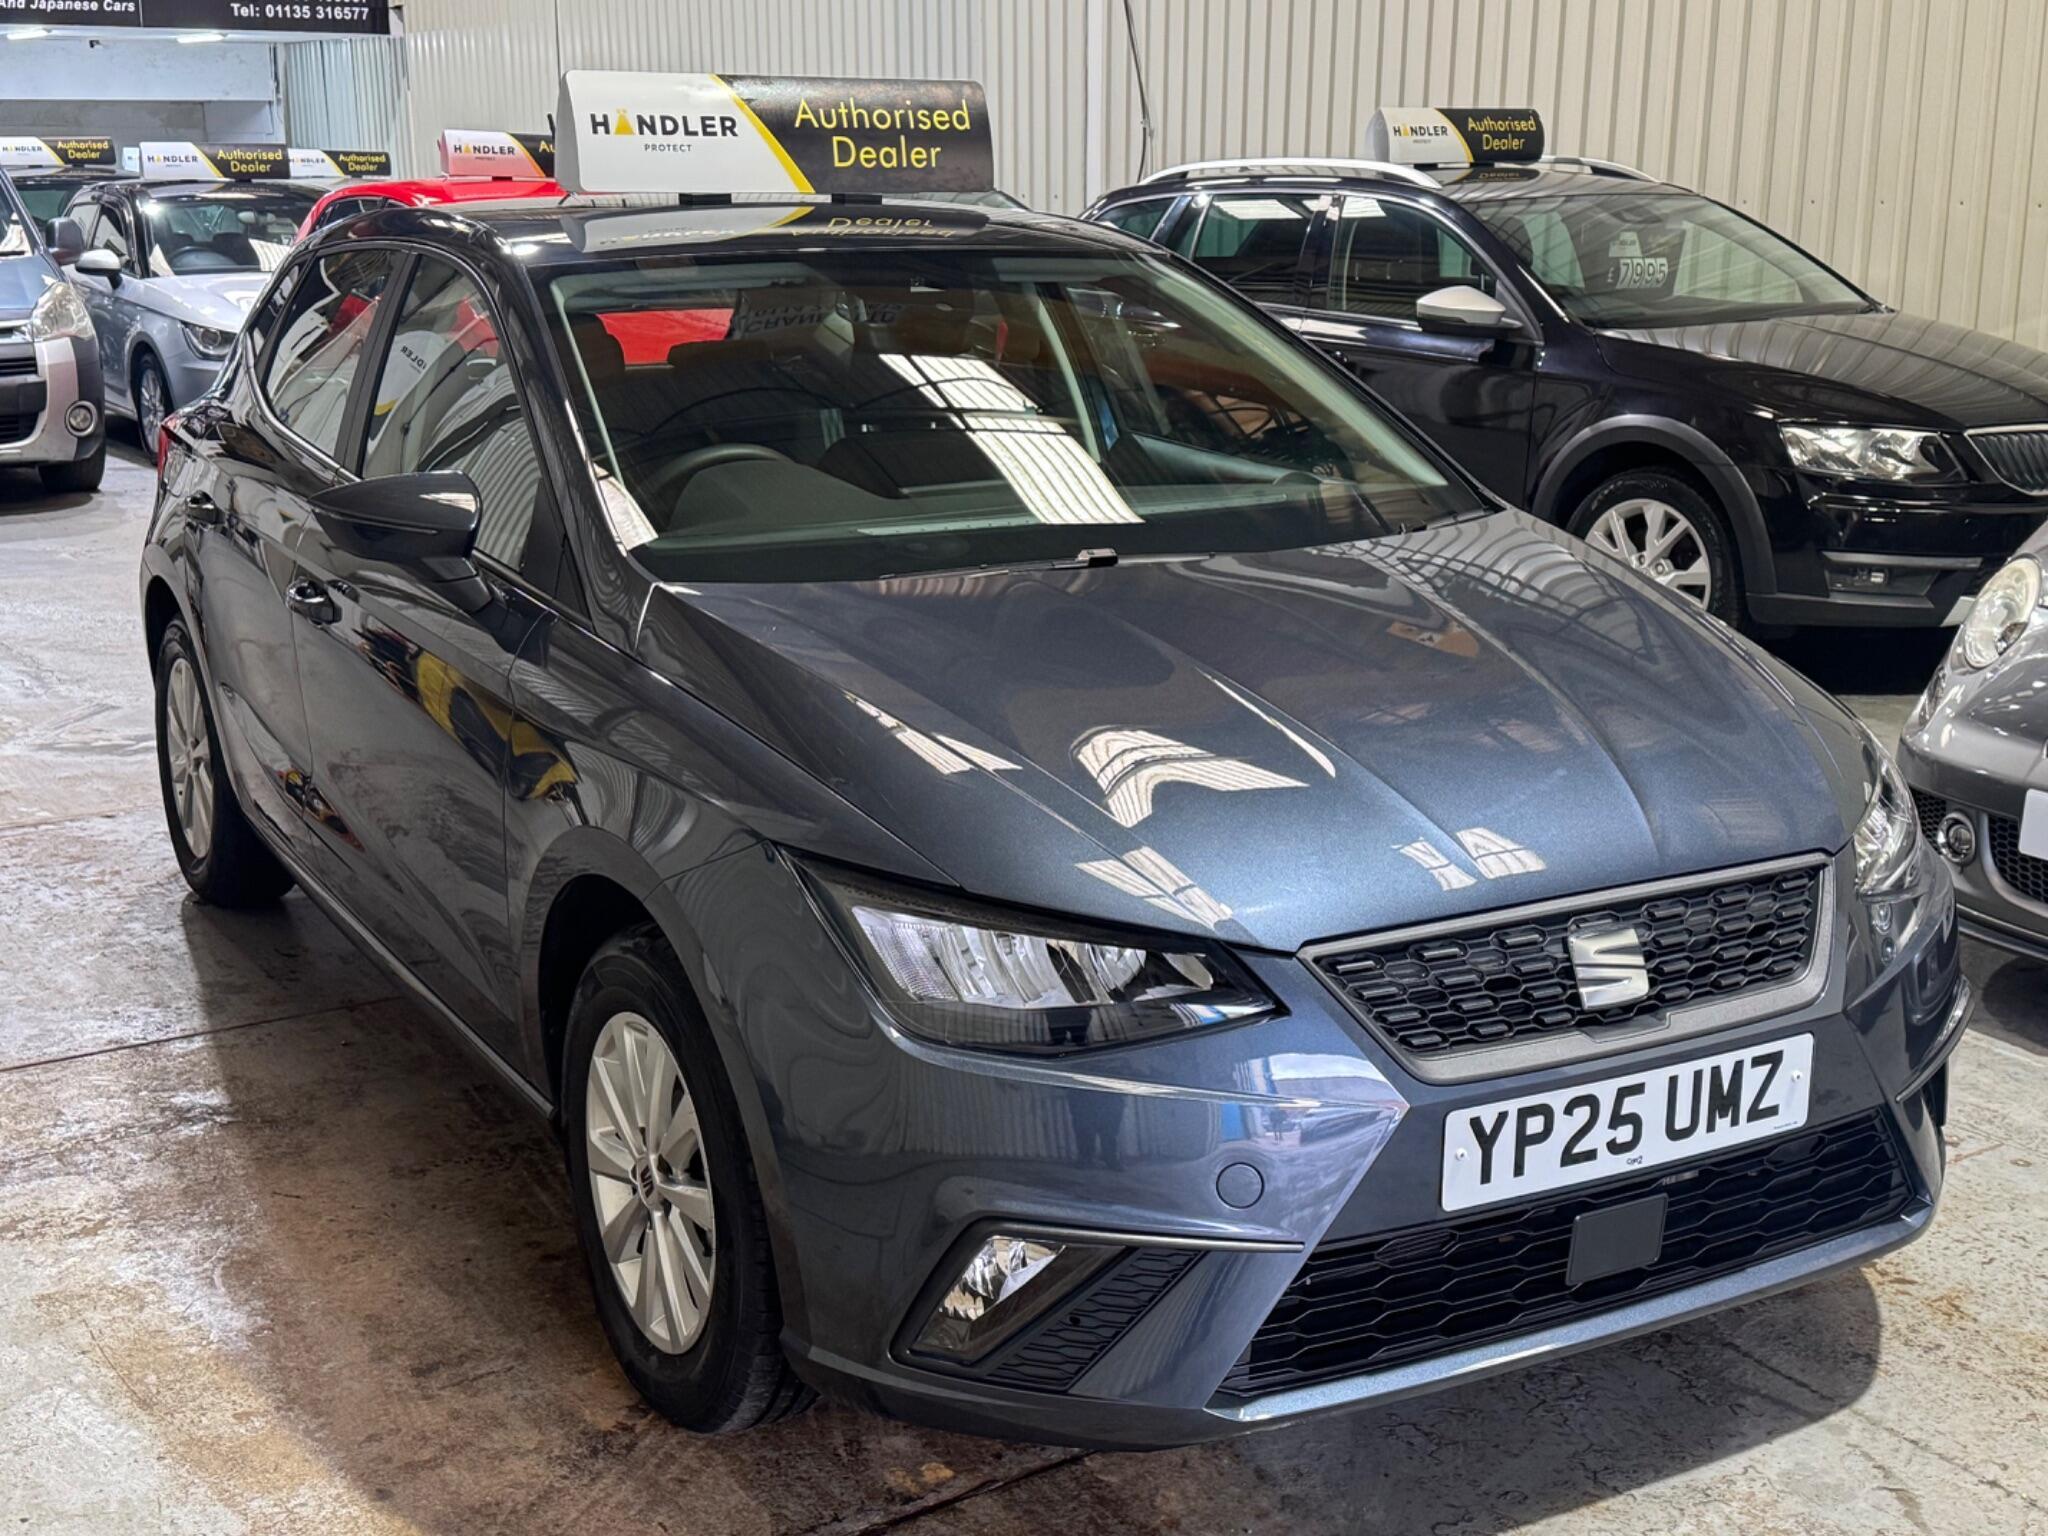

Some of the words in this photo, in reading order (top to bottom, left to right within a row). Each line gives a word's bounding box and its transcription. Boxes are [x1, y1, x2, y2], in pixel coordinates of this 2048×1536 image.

[30, 0, 99, 12] Japanese
[103, 0, 136, 12] Cars
[230, 3, 260, 18] Tel:
[265, 4, 311, 19] 01135
[315, 6, 370, 21] 316577
[793, 97, 971, 132] Authorised
[1467, 116, 1537, 132] Authorised
[57, 139, 110, 149] Authorised
[644, 142, 692, 154] PROTECT
[1482, 133, 1526, 150] Dealer
[68, 149, 101, 159] Dealer
[217, 148, 282, 160] Authorised
[339, 153, 387, 163] Authorised
[831, 135, 942, 170] Dealer
[231, 160, 272, 173] Dealer
[348, 161, 378, 172] Dealer
[1622, 261, 1667, 284] 7995
[1469, 1082, 1647, 1185] YP25
[1663, 1050, 1785, 1142] UMZ
